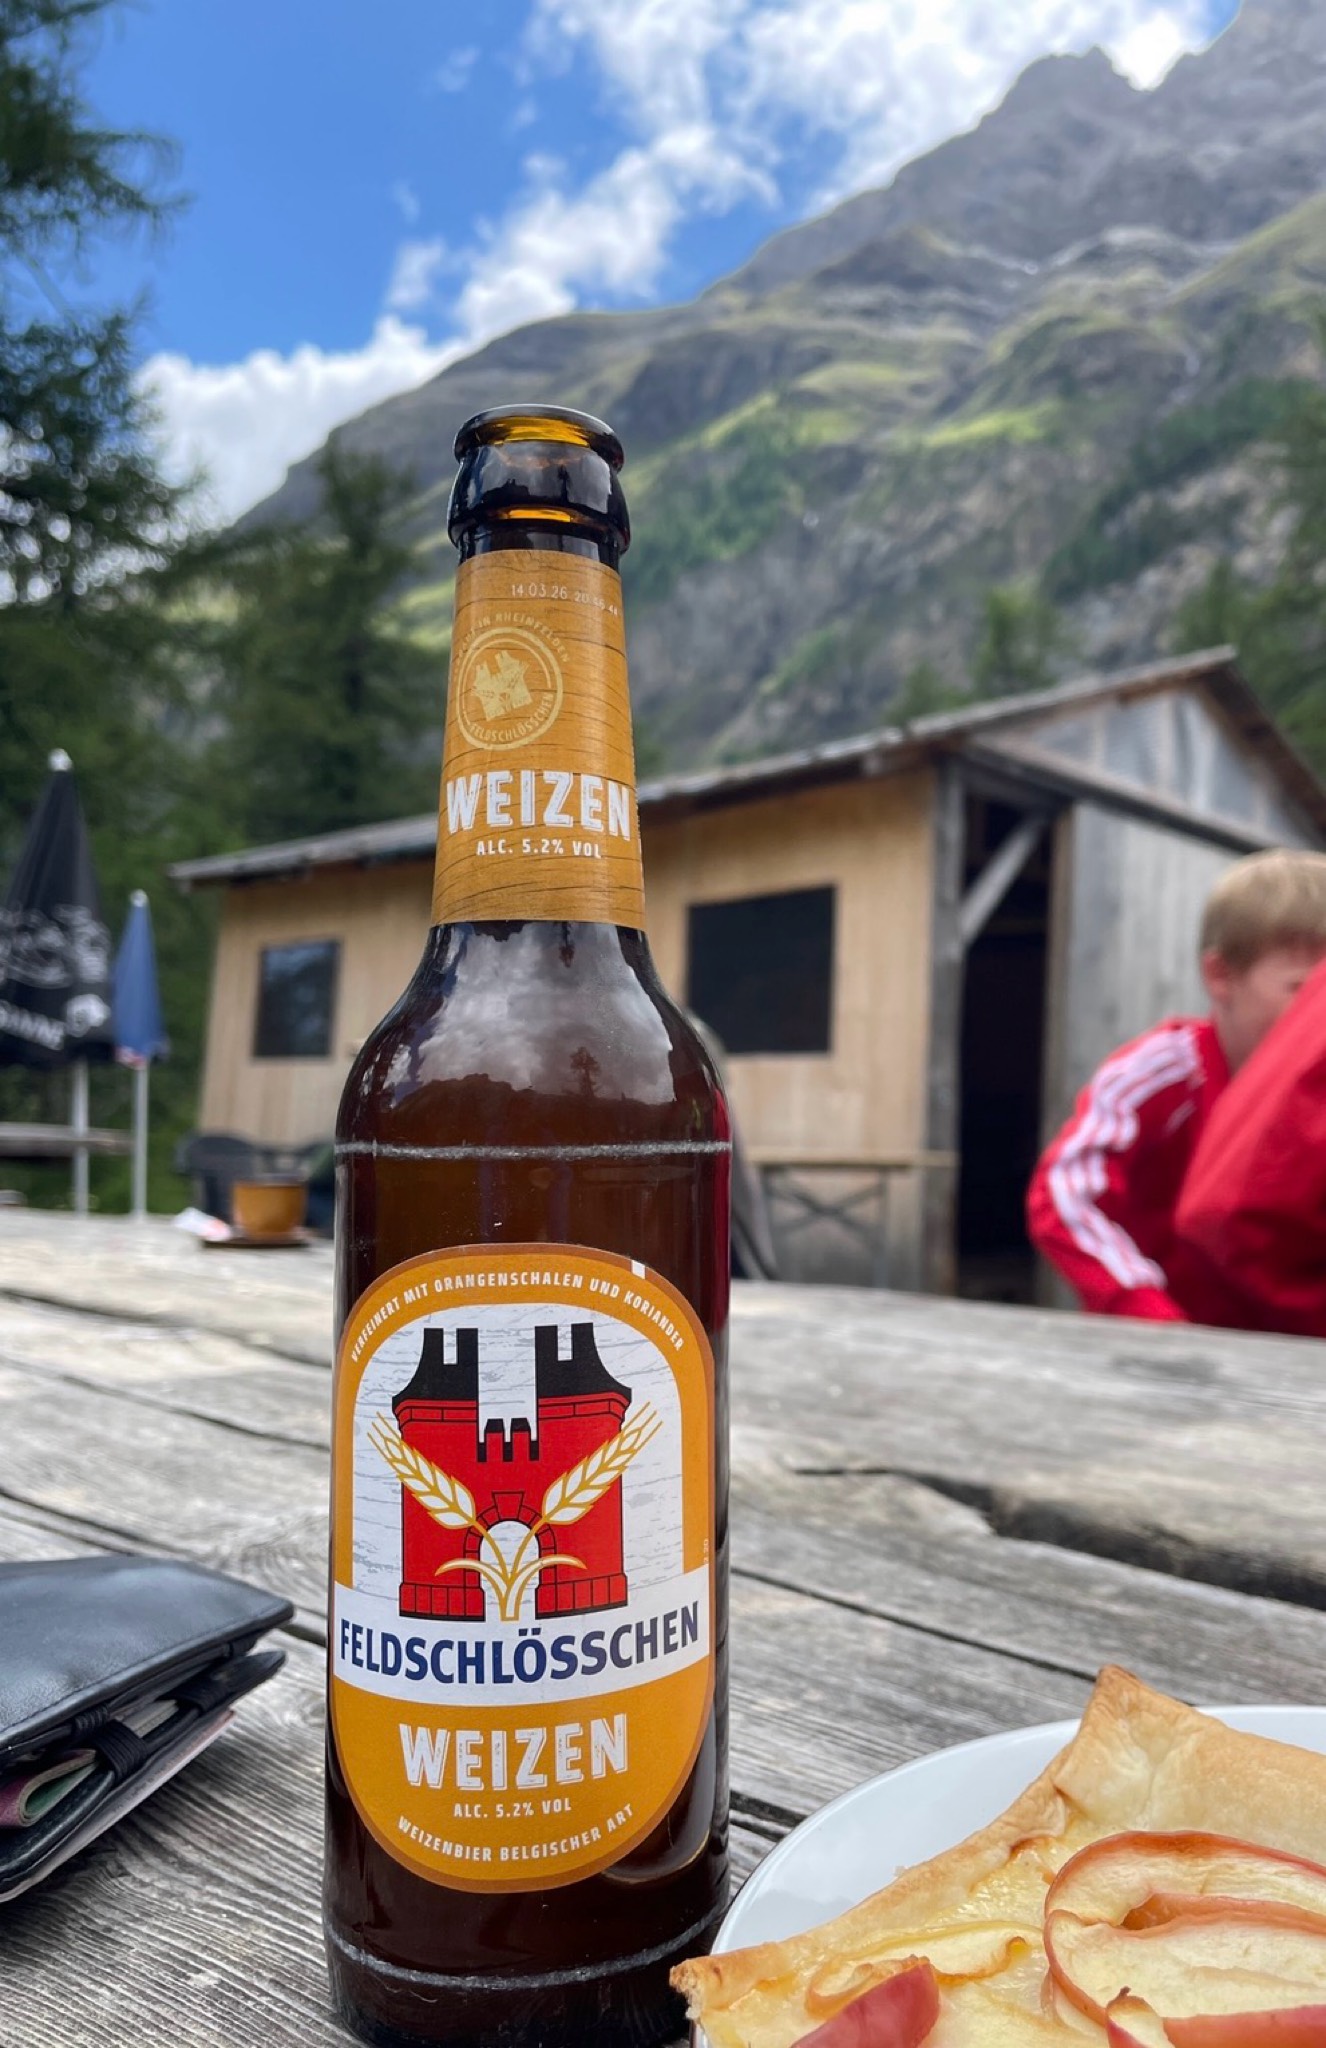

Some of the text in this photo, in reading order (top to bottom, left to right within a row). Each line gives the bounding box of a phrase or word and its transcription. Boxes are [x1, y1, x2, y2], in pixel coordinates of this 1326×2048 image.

[495, 611, 571, 664] RHEINFELDEN
[446, 769, 631, 841] WEIZEN
[476, 838, 602, 859] ALC. 5.2% VOL
[351, 1271, 684, 1363] VERFEINERT MIT ORANGENSCHALEN UND KORIANDER
[340, 1600, 700, 1685] FELDSCHLÖSSCHEN
[399, 1713, 628, 1791] WEIZEN
[397, 1804, 634, 1863] WEIZENBIER BELGISCHER ART
[453, 1798, 572, 1818] ALC. 5.2% VOL
